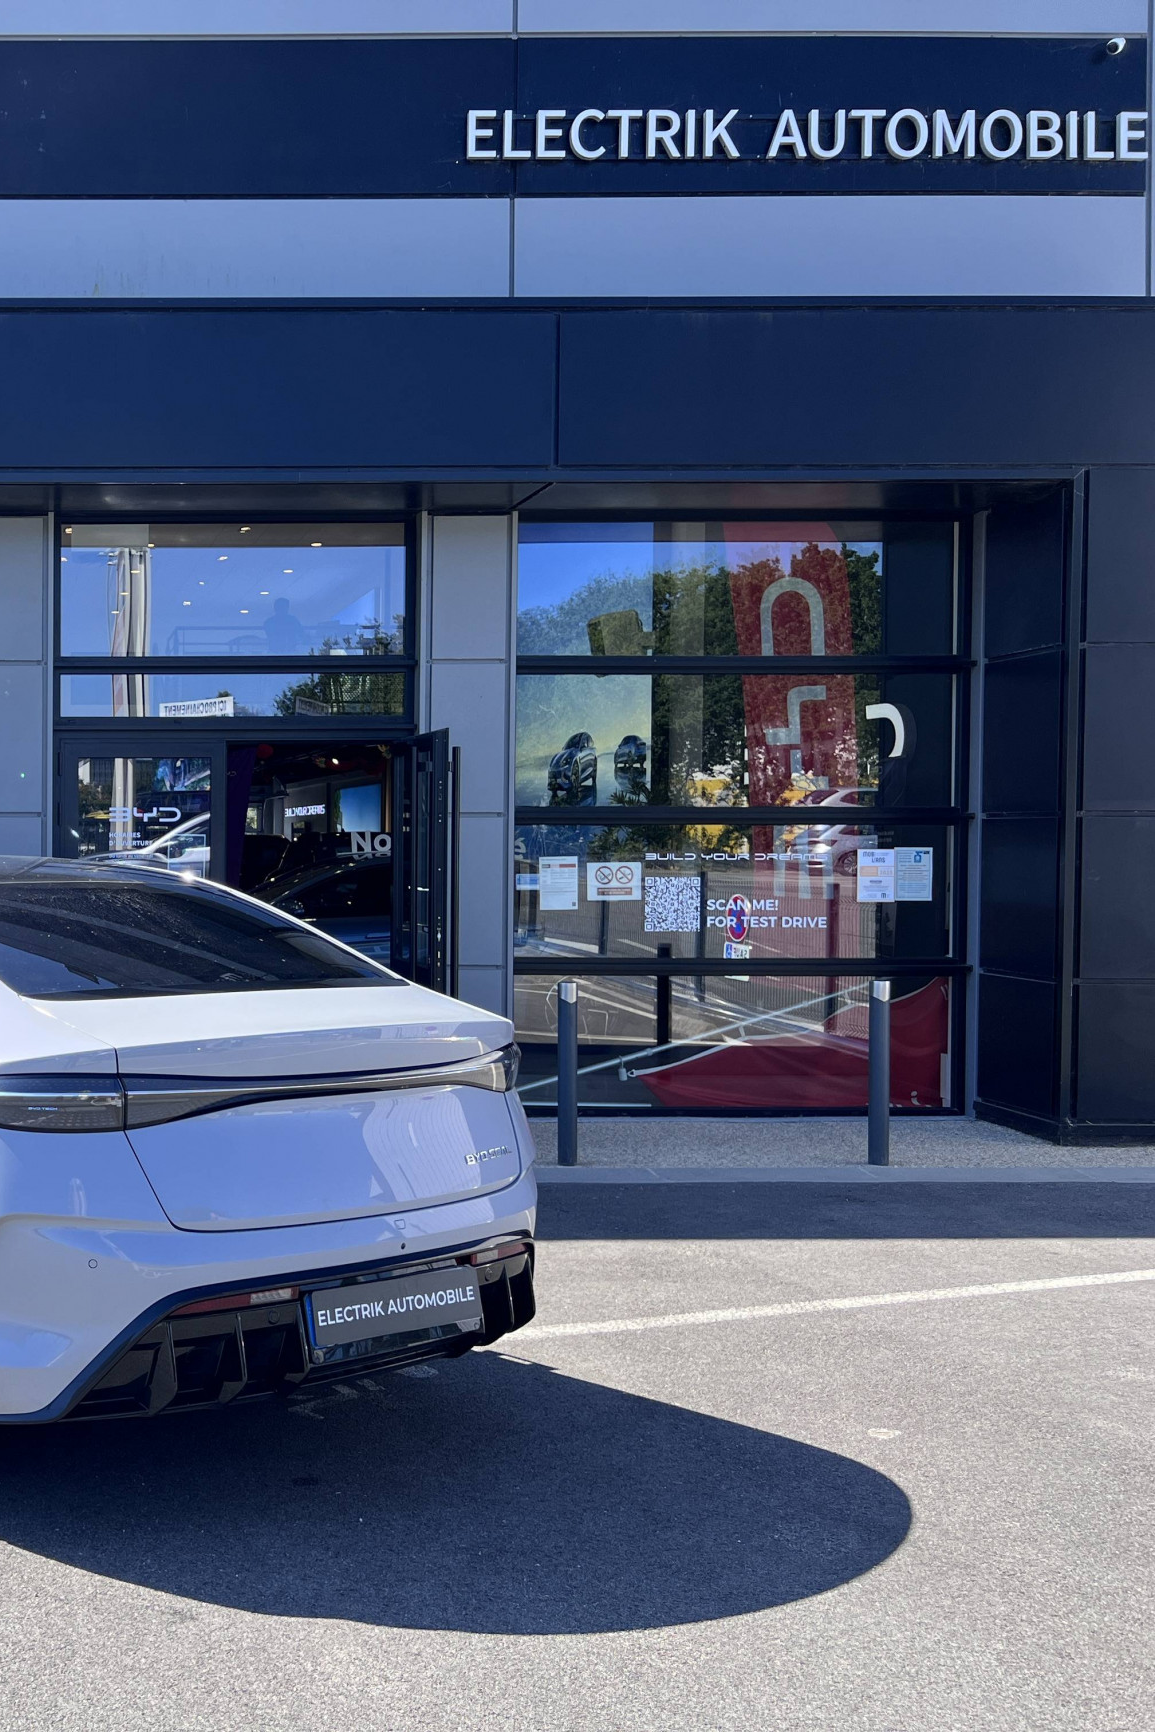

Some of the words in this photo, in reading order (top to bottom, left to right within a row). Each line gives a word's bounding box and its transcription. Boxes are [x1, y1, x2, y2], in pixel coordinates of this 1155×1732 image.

[466, 108, 740, 160] ELECTRIK
[766, 108, 1149, 160] AUTOMOBILE
[109, 807, 182, 822] BYD
[645, 853, 696, 861] BUILD
[701, 853, 750, 861] YOUR
[754, 853, 828, 861] DREAMS
[706, 899, 746, 911] SCAN
[752, 899, 779, 911] ME!
[706, 916, 737, 928] FOR
[741, 916, 778, 928] TEST
[782, 916, 828, 928] DRIVE
[318, 1301, 385, 1327] ELECTRIK
[387, 1286, 475, 1315] AUTOMOBILE
